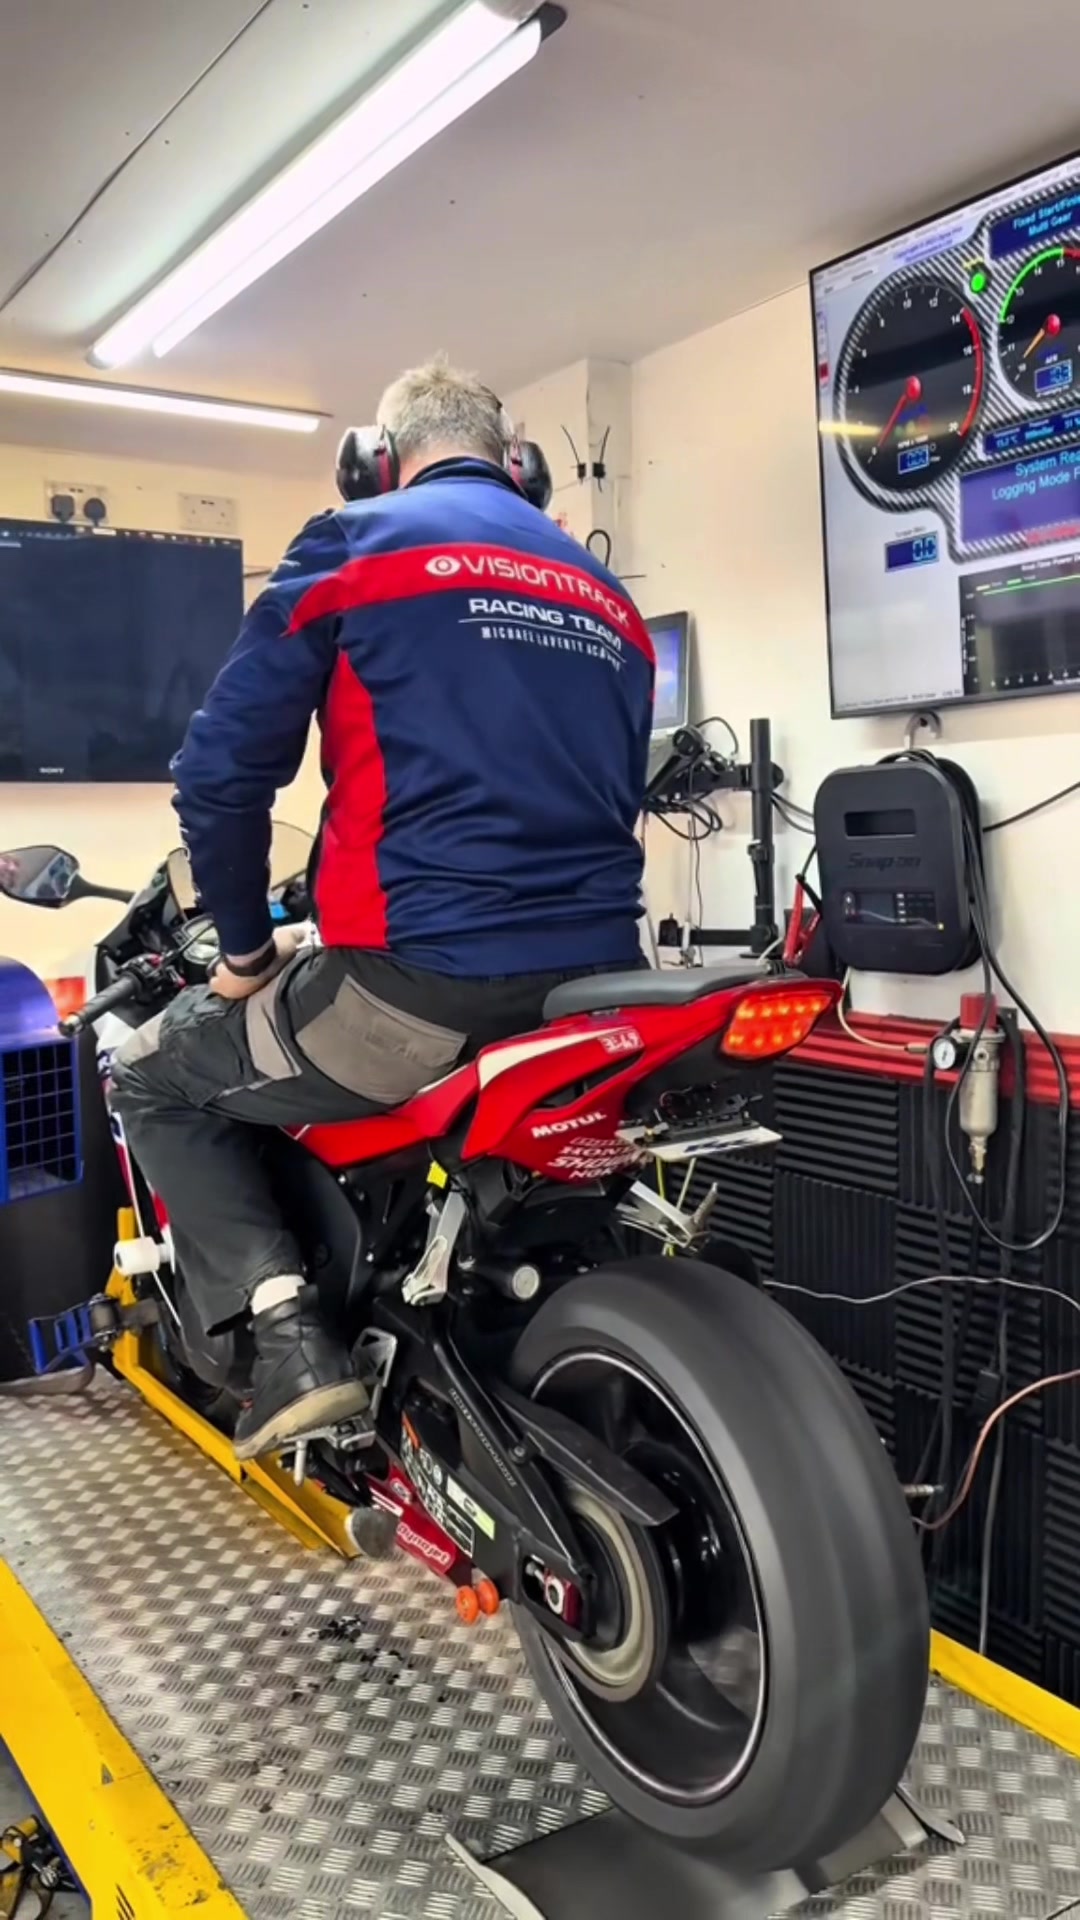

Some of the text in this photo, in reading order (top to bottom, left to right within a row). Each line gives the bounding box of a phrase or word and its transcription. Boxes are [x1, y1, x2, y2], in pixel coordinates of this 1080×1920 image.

[1016, 457, 1057, 477] System
[992, 480, 1036, 500] Logging
[1039, 471, 1070, 488] Mode
[463, 556, 631, 628] VISIONTRACK
[469, 598, 622, 651] RACING TEAM
[481, 626, 534, 643] MICHAEL
[531, 1111, 607, 1138] MOTUL
